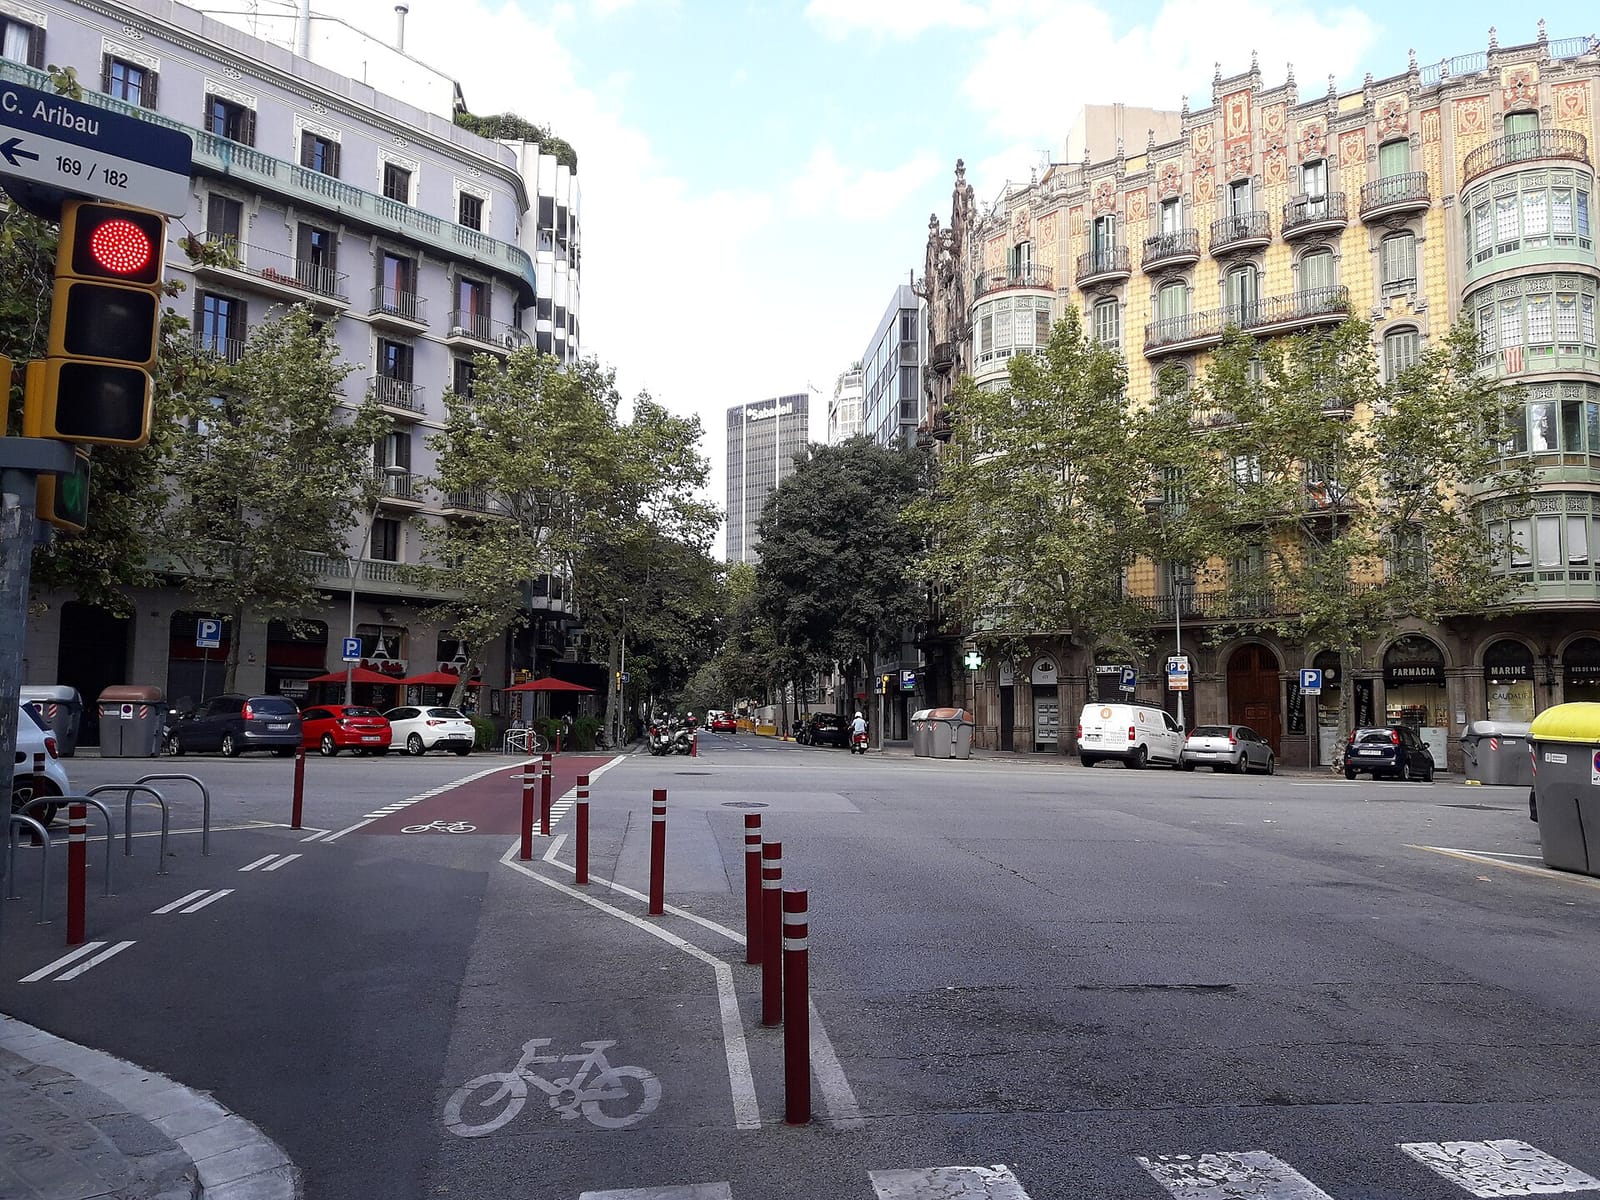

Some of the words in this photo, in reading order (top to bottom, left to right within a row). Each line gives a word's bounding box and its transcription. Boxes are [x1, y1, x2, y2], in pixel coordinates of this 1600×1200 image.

[2, 91, 23, 115] C.
[32, 101, 99, 135] Aribau
[56, 155, 82, 176] 169
[102, 169, 129, 189] 182
[751, 402, 792, 420] Sabadell
[201, 621, 217, 638] P
[346, 640, 358, 656] P
[1122, 669, 1135, 683] P
[1304, 671, 1317, 687] P
[1392, 666, 1436, 676] FARMÀCIA
